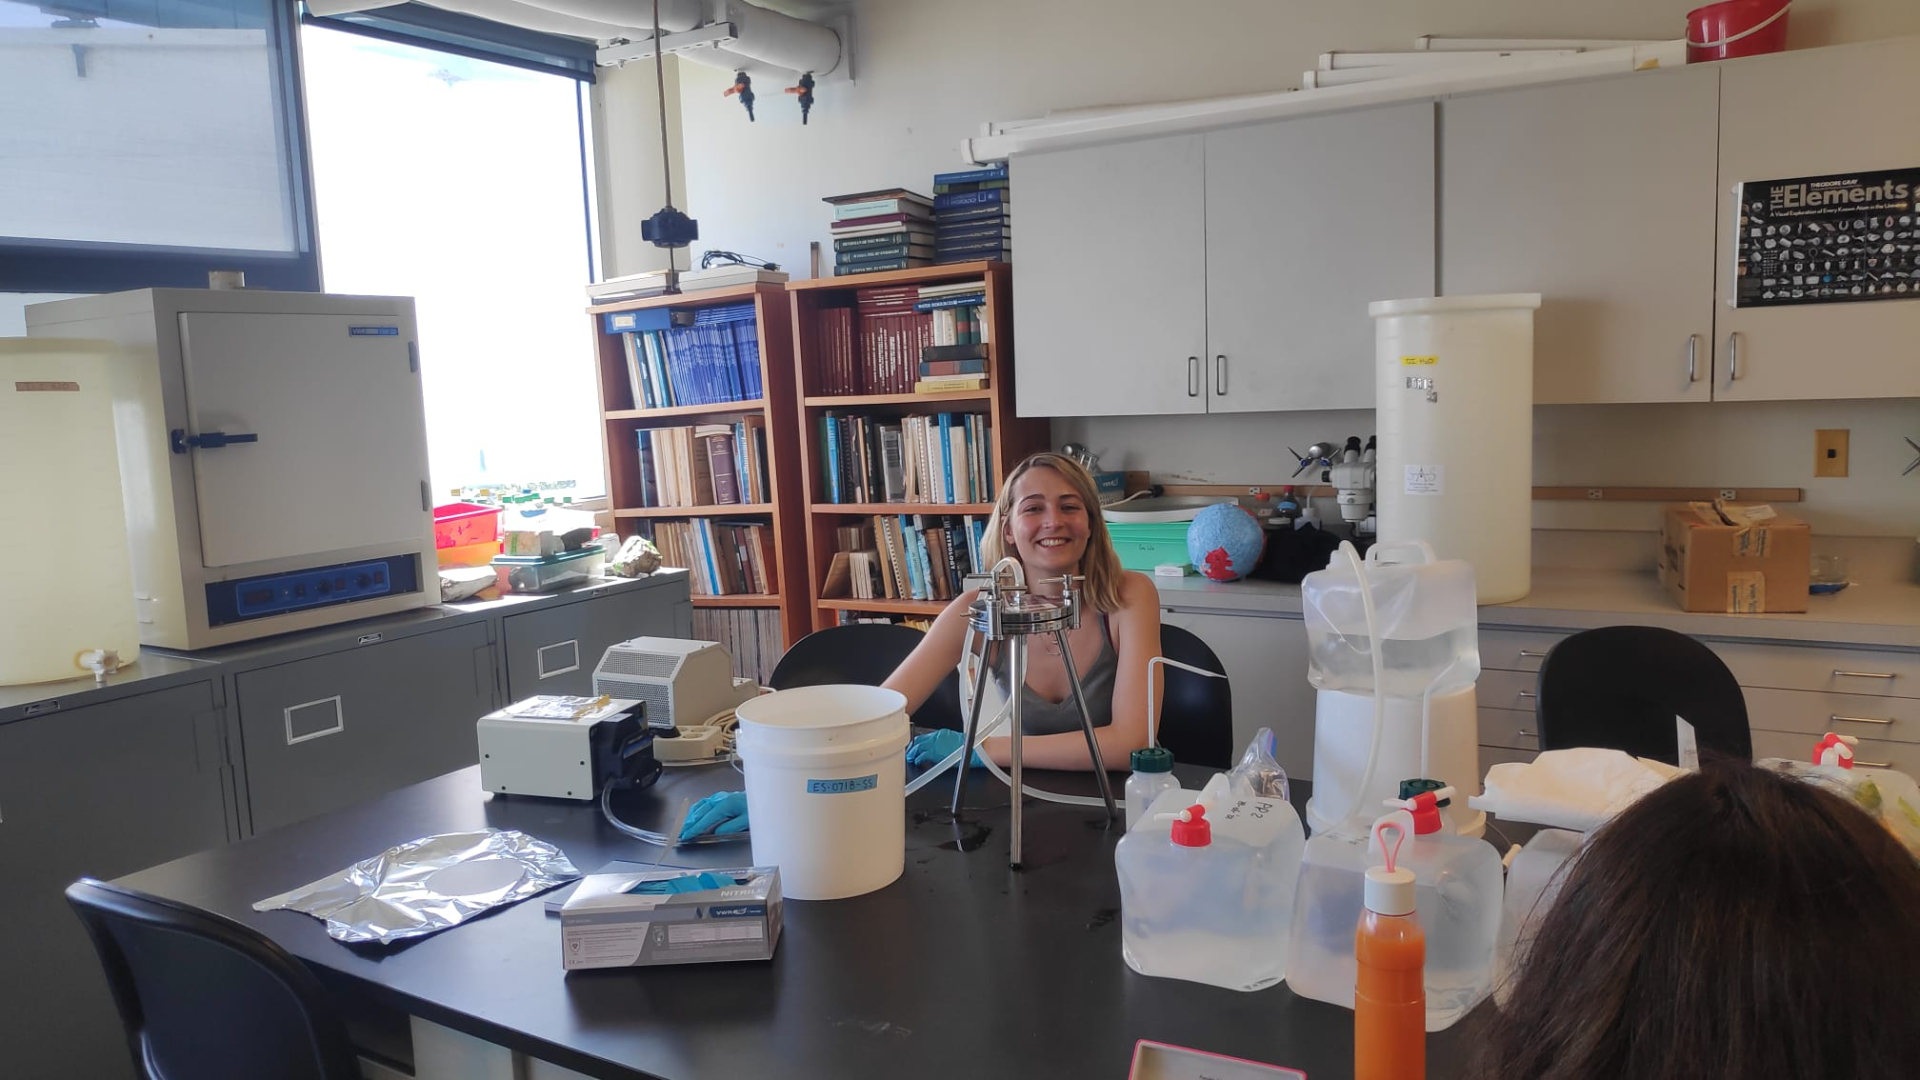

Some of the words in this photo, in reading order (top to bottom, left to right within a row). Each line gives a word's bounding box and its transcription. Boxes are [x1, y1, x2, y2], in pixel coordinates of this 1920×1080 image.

[1770, 185, 1784, 211] THE
[1784, 180, 1909, 208] Elements
[945, 530, 956, 570] PETROLOGY
